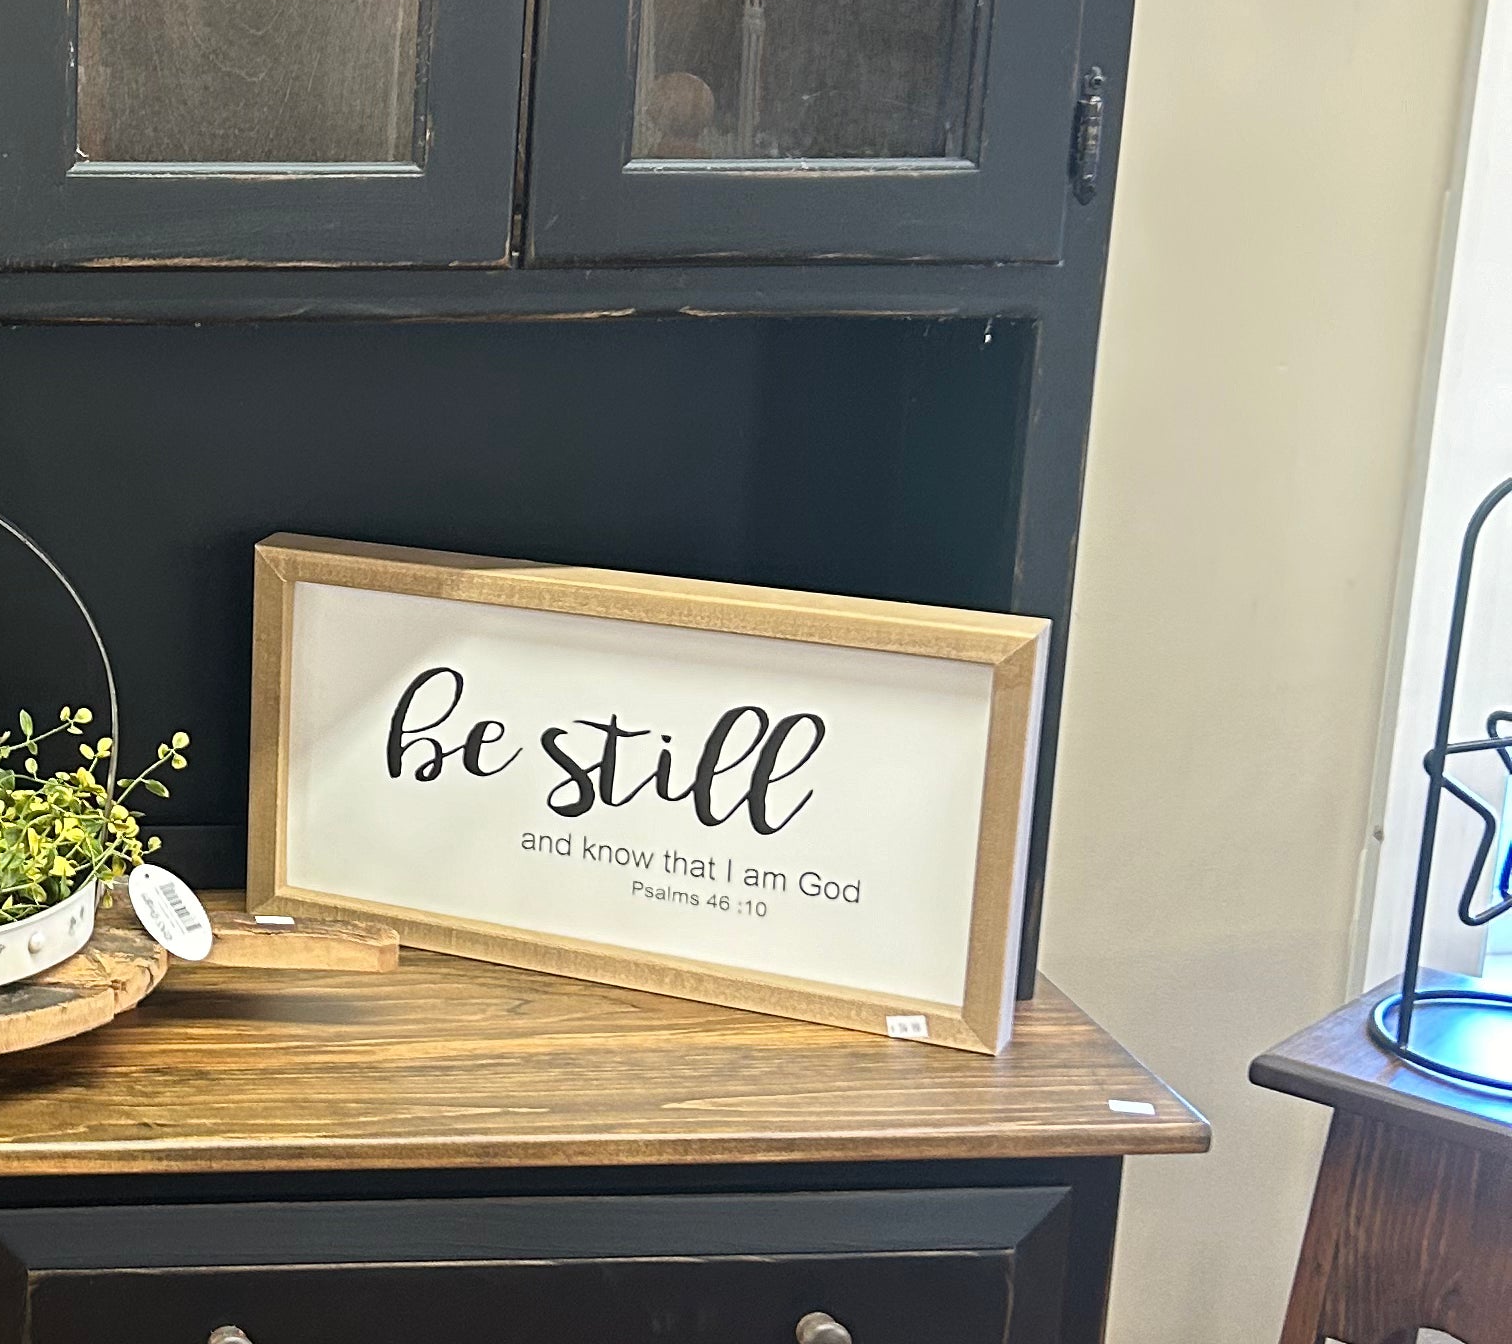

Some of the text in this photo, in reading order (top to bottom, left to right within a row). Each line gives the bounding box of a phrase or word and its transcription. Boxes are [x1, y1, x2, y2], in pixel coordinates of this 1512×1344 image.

[387, 666, 826, 836] be still
[520, 832, 862, 905] and know that I am God
[631, 880, 701, 908] Psalms
[706, 893, 731, 912] 46
